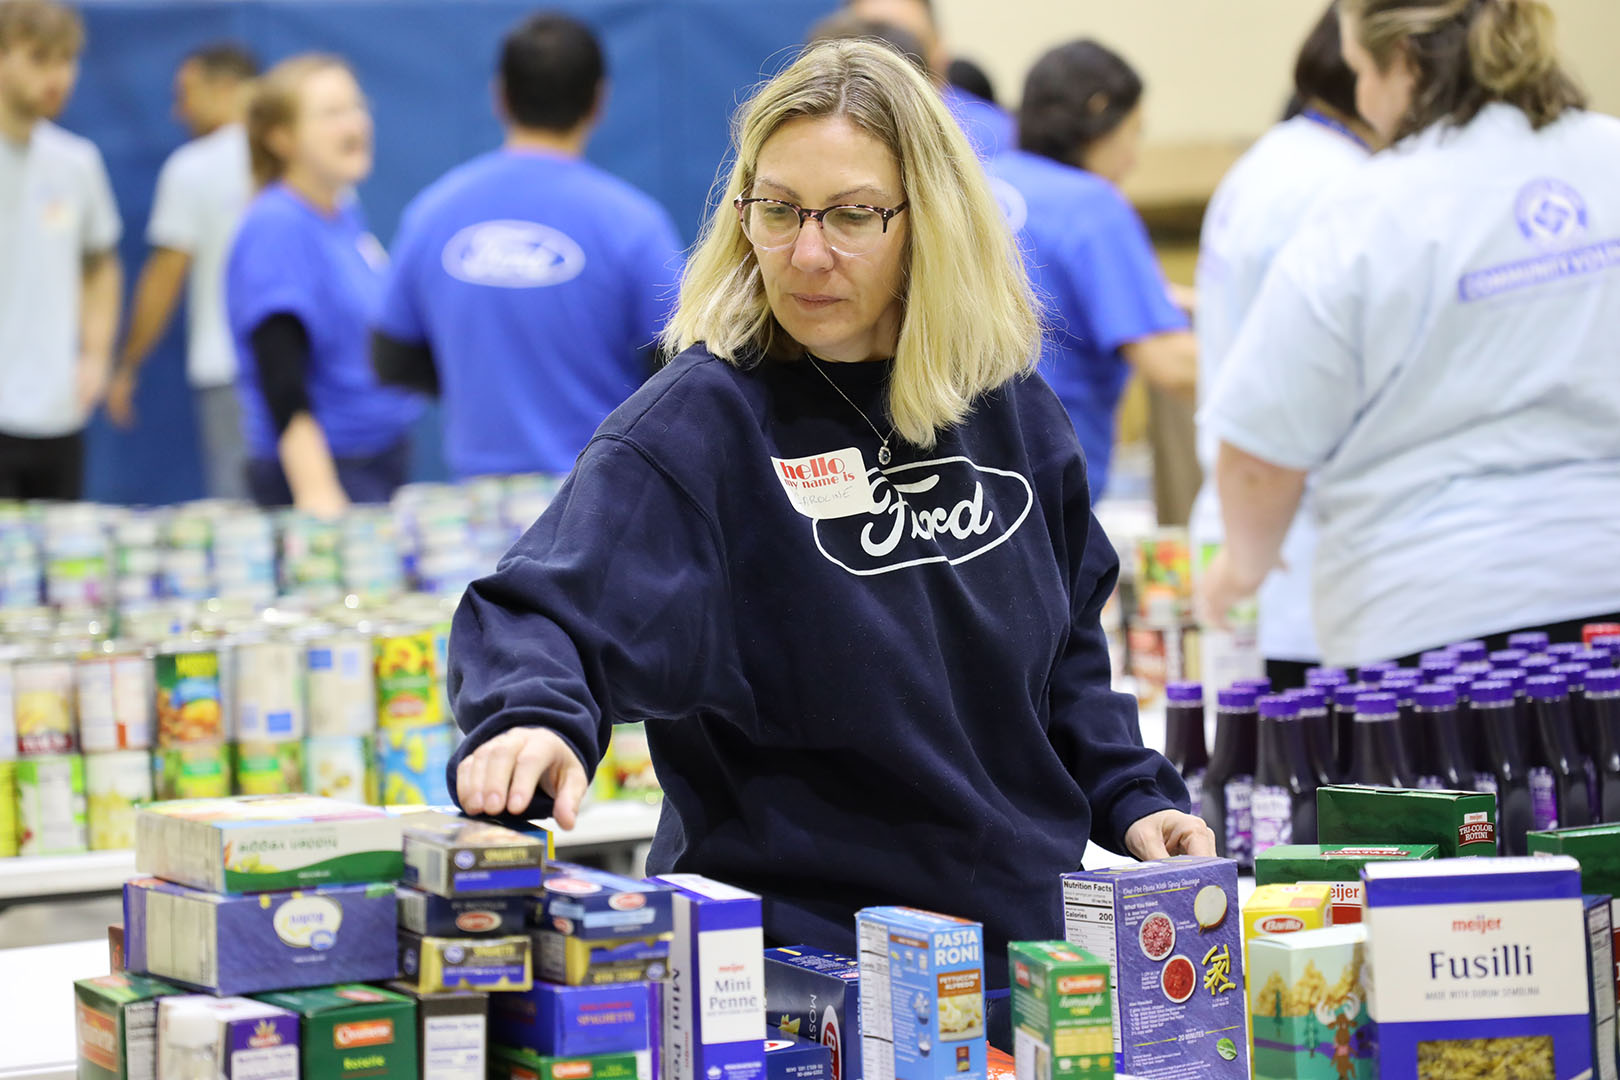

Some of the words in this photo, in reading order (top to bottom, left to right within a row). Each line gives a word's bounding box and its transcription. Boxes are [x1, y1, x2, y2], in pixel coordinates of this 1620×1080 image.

[780, 457, 845, 480] hello
[785, 479, 798, 489] my
[802, 475, 839, 489] name
[843, 471, 855, 482] is
[861, 474, 994, 557] Ford
[1458, 823, 1494, 836] TRI-COLOR
[1465, 832, 1488, 841] ROTINI
[1063, 880, 1092, 891] Nutrition
[1093, 883, 1112, 893] Facts
[1330, 884, 1360, 901] eijer
[1065, 910, 1088, 920] Calories
[1099, 912, 1113, 922] 200
[1451, 915, 1502, 935] meijer
[934, 929, 979, 948] PASTA
[935, 945, 980, 966] RONI
[1429, 944, 1533, 980] Fusilli
[714, 977, 752, 993] Mini
[709, 996, 758, 1010] Penne
